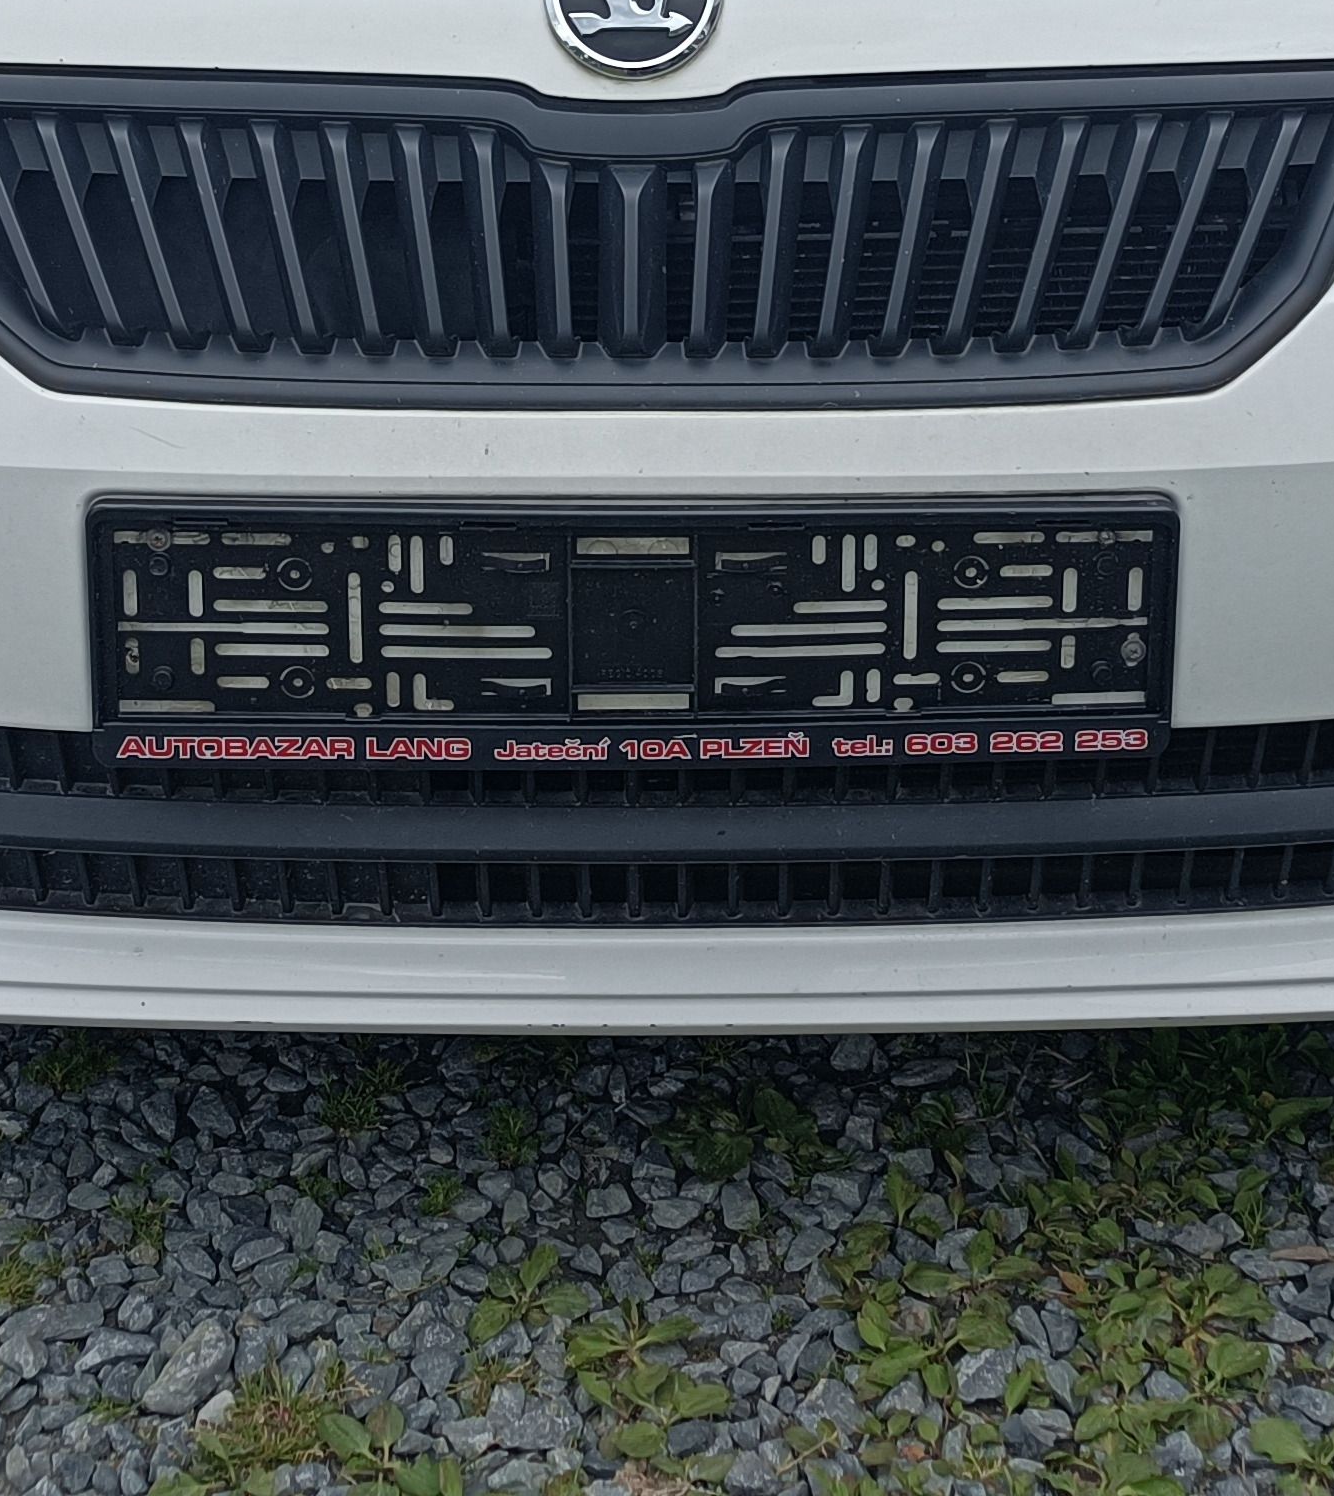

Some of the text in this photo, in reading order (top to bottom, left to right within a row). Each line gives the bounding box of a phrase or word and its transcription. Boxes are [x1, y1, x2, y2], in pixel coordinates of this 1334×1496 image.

[116, 729, 1149, 761] AUTOBAZAR LANG Jateční 10A PLZEŇ tel.: 603 262 253
